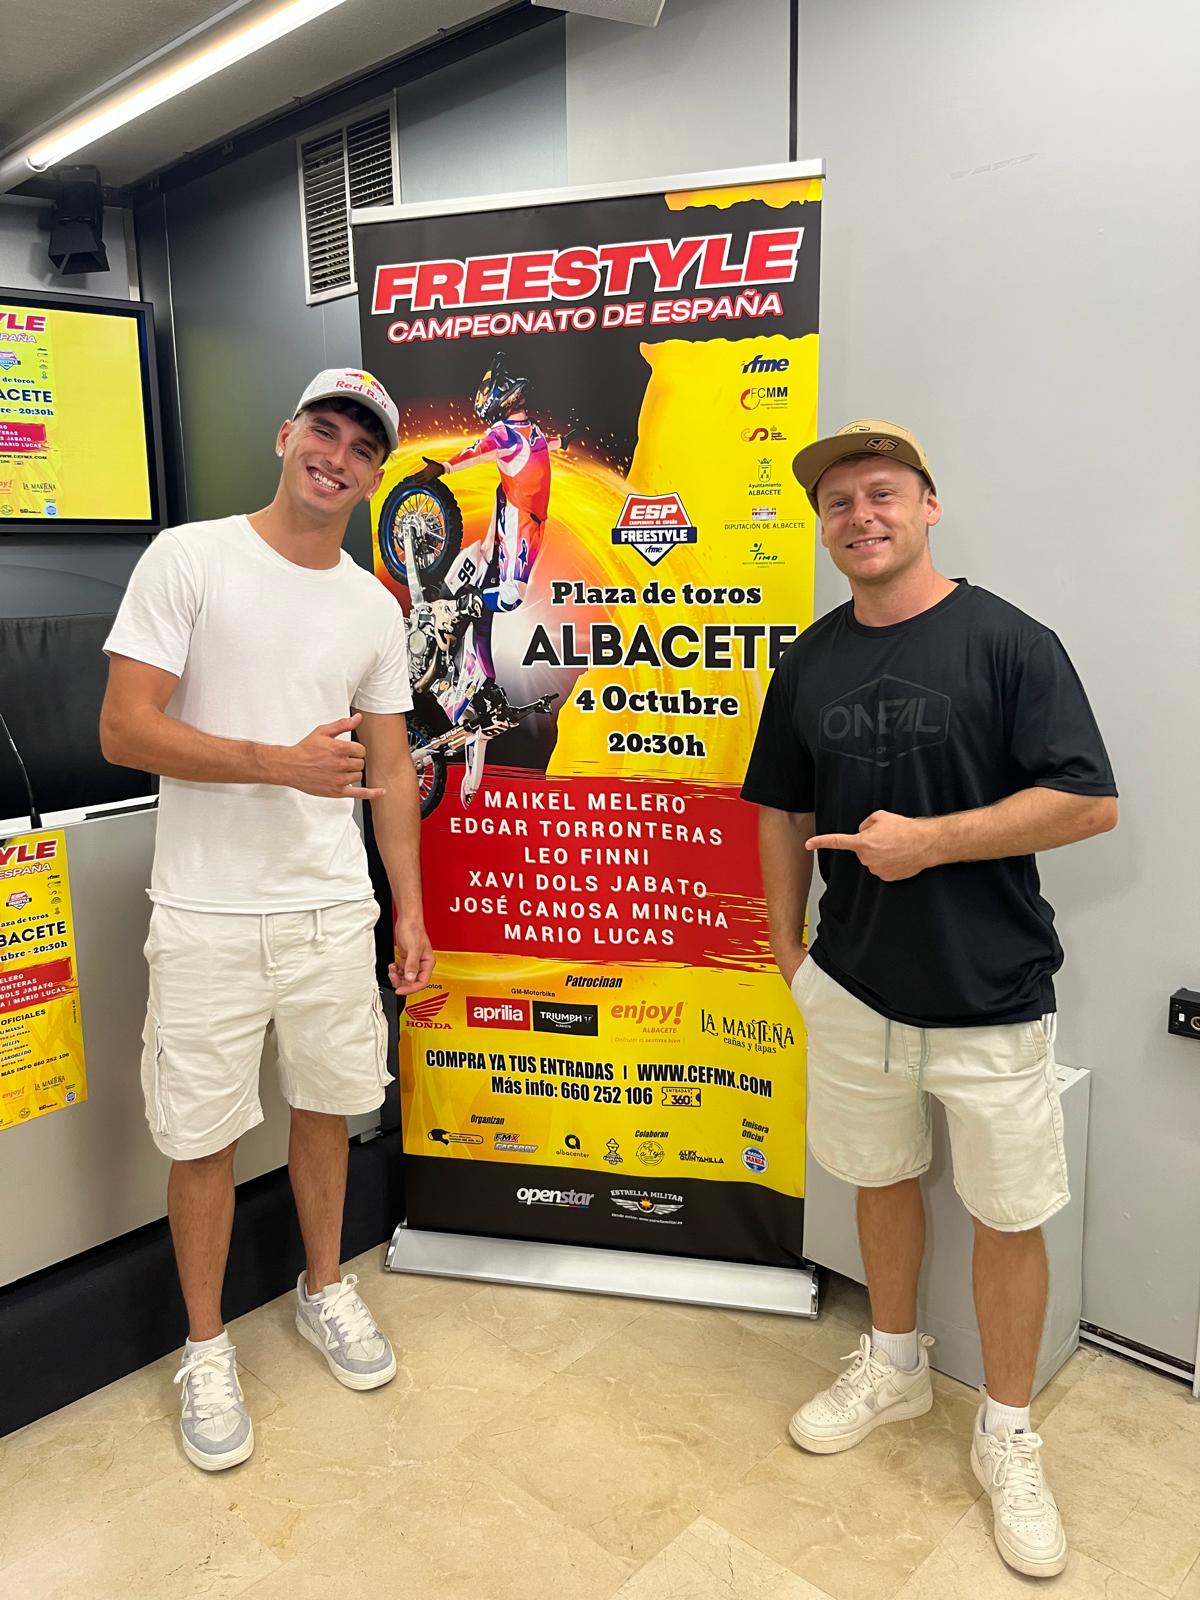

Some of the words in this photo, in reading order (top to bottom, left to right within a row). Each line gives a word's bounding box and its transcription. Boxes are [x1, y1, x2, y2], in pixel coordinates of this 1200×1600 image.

[371, 227, 804, 315] FREESTYLE
[387, 306, 596, 344] CAMPEONATO
[601, 302, 647, 329] DE
[651, 289, 783, 325] ESPAÑA
[336, 380, 363, 392] Red
[751, 386, 788, 399] FCMM
[630, 504, 678, 520] ESP
[620, 529, 688, 543] FREESTYLE
[551, 581, 637, 605] Plaza
[642, 583, 676, 604] de
[682, 584, 762, 605] toros
[521, 624, 799, 670] ALBACETE
[576, 689, 596, 712] 4
[602, 686, 738, 716] Octubre
[608, 732, 706, 758] 20:30h
[484, 790, 576, 811] MAIKEL
[588, 792, 687, 814] MELERO
[450, 817, 529, 836] EDGAR
[539, 820, 723, 846] TORRONTERAS
[0, 839, 58, 867] YLE
[524, 846, 568, 865] LEO
[581, 848, 649, 866] FINNI
[468, 870, 524, 890] XAVI
[536, 873, 598, 892] DOLS
[610, 875, 708, 898] JABATO
[28, 914, 49, 922] toros
[449, 895, 508, 916] JOSÉ
[519, 899, 620, 920] CANOSA
[632, 903, 729, 930] MINCHA
[0, 921, 66, 948] BACETE
[504, 923, 582, 944] MARIO
[594, 926, 675, 946] LUCAS
[0, 951, 26, 962] ubre
[33, 940, 68, 954] 20:30h
[0, 978, 37, 992] ONTERAS
[23, 982, 54, 994] JABATO
[565, 975, 623, 988] Patrocinan
[14, 993, 38, 1004] MARIO
[42, 986, 66, 997] LUCAS
[511, 988, 556, 998] GM-Motorbike
[0, 1008, 46, 1026] OFICIALES
[473, 1004, 524, 1022] aprilia
[540, 1010, 582, 1024] TRIUMPH
[610, 1000, 684, 1025] enjoy!
[405, 1020, 452, 1030] HONDA
[701, 1008, 719, 1036] LA
[722, 1016, 794, 1049] MARTEÑA
[723, 1036, 746, 1048] cañas
[748, 1042, 752, 1052] y
[754, 1042, 777, 1054] tapas
[17, 1064, 32, 1072] INFO
[426, 1049, 486, 1070] COMPRA
[488, 1054, 506, 1072] YA
[508, 1055, 536, 1073] TUS
[540, 1058, 614, 1080] ENTRADAS
[637, 1064, 772, 1098] WWW.CEFMX.COM
[492, 1076, 522, 1096] Más
[525, 1078, 558, 1098] info:
[560, 1082, 590, 1101] 660
[594, 1086, 622, 1104] 252
[625, 1086, 653, 1105] 106
[671, 1095, 691, 1105] 360
[470, 1114, 505, 1126] Organizan
[742, 1118, 770, 1134] Emisora
[495, 1134, 520, 1142] FMX
[634, 1130, 670, 1138] Colaboran
[742, 1130, 764, 1142] Oficial
[556, 1149, 590, 1158] albacenter
[680, 1154, 724, 1164] QUINTANILLA
[516, 1187, 594, 1206] openstar
[650, 1192, 683, 1202] MILITAR
